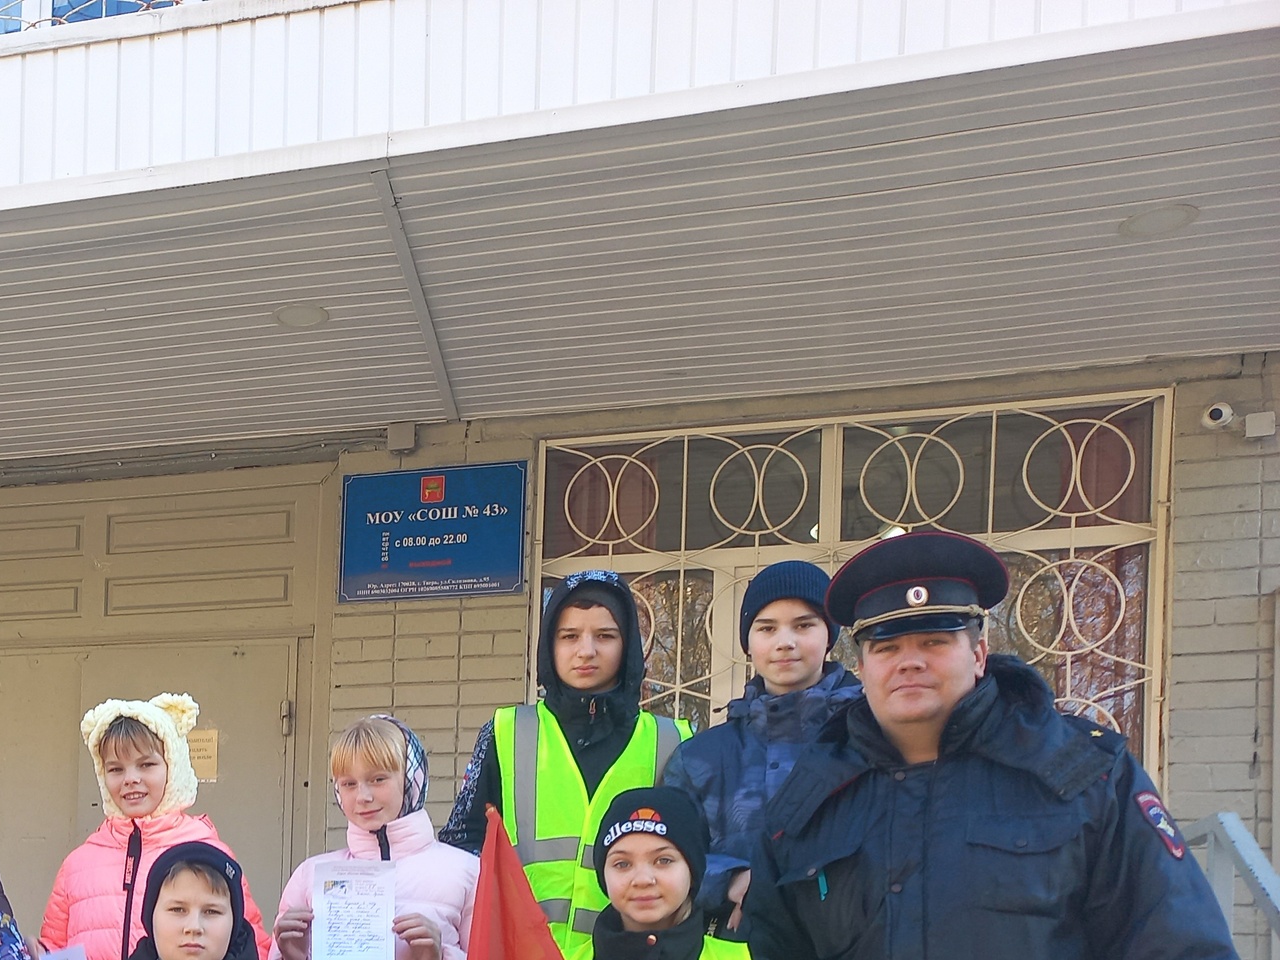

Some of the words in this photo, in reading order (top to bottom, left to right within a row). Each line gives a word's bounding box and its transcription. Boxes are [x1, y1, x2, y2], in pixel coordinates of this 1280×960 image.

[366, 510, 404, 525] МОУ
[408, 506, 458, 522] «СОШ
[462, 505, 479, 518] №
[482, 503, 508, 517] 43»
[394, 539, 401, 548] с
[402, 536, 427, 547] 08.00
[428, 537, 441, 547] до
[442, 533, 468, 544] 22.00
[603, 820, 667, 847] ellesse
